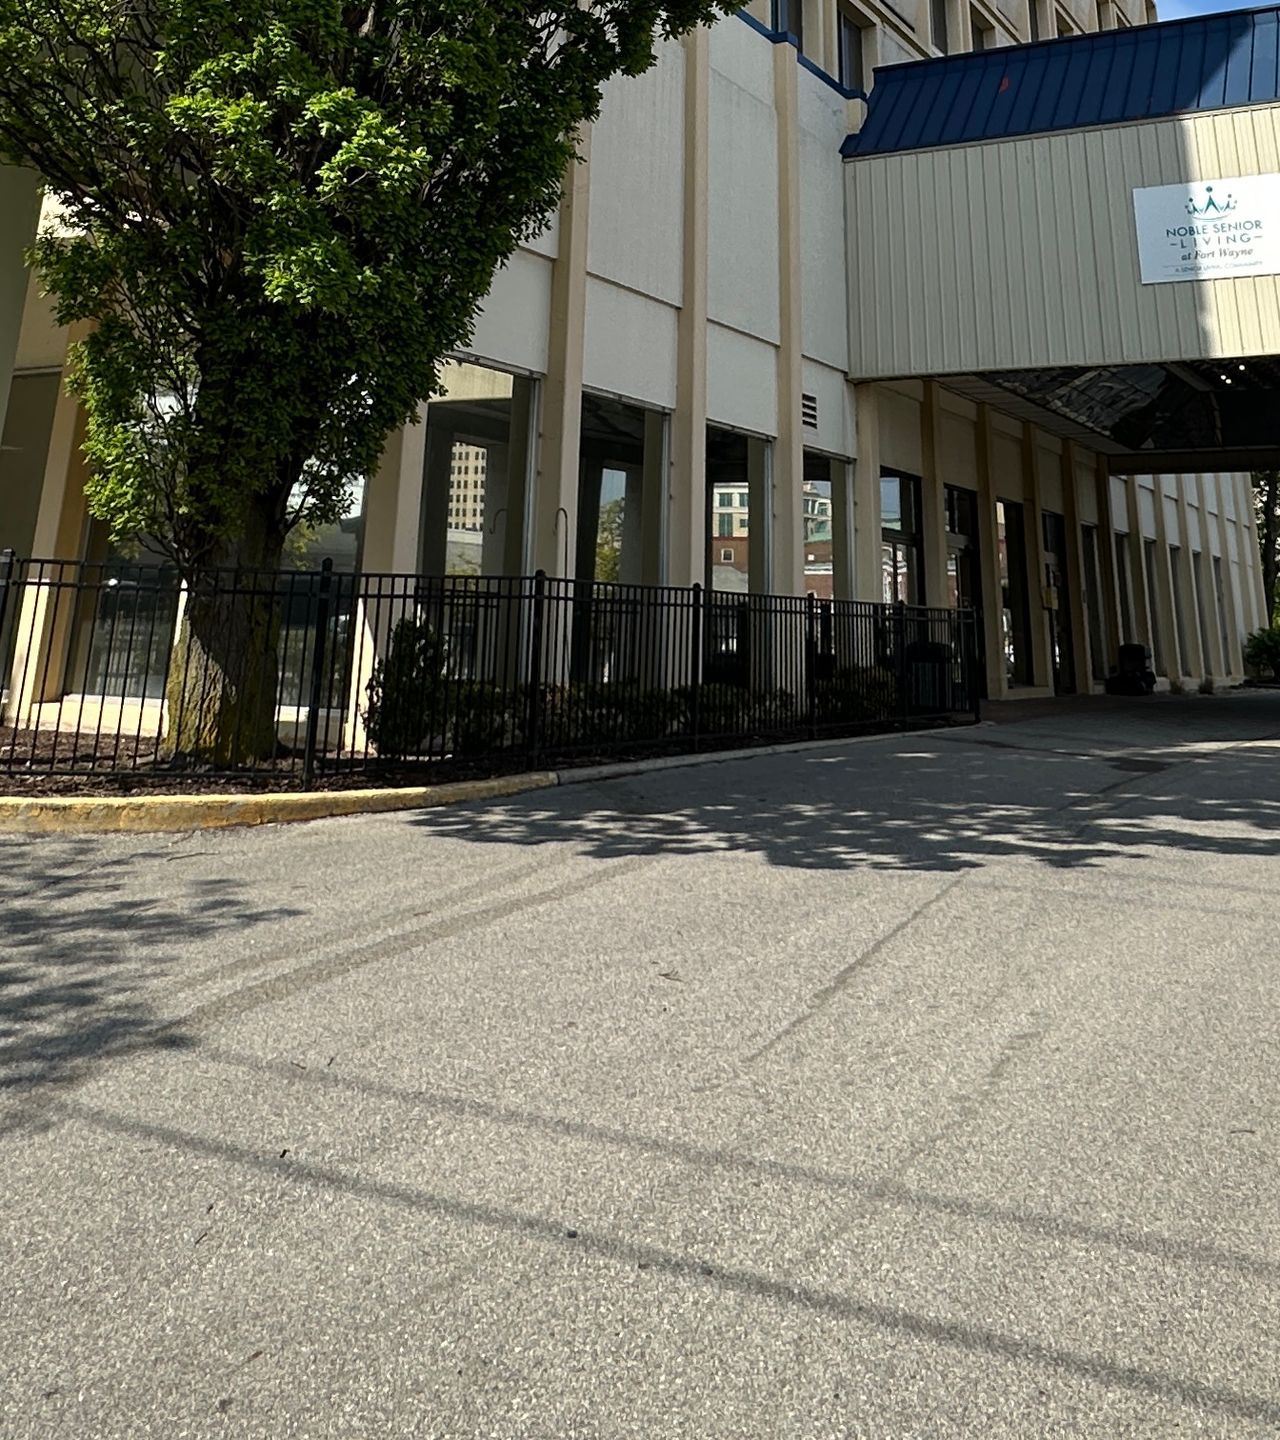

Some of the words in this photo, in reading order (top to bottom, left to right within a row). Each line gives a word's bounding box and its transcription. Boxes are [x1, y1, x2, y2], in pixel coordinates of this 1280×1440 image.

[1165, 224, 1209, 238] NOBLE
[1212, 220, 1263, 234] SENIOR
[1180, 233, 1252, 249] LIVING
[1193, 250, 1216, 260] Fort
[1218, 247, 1254, 259] Wayne
